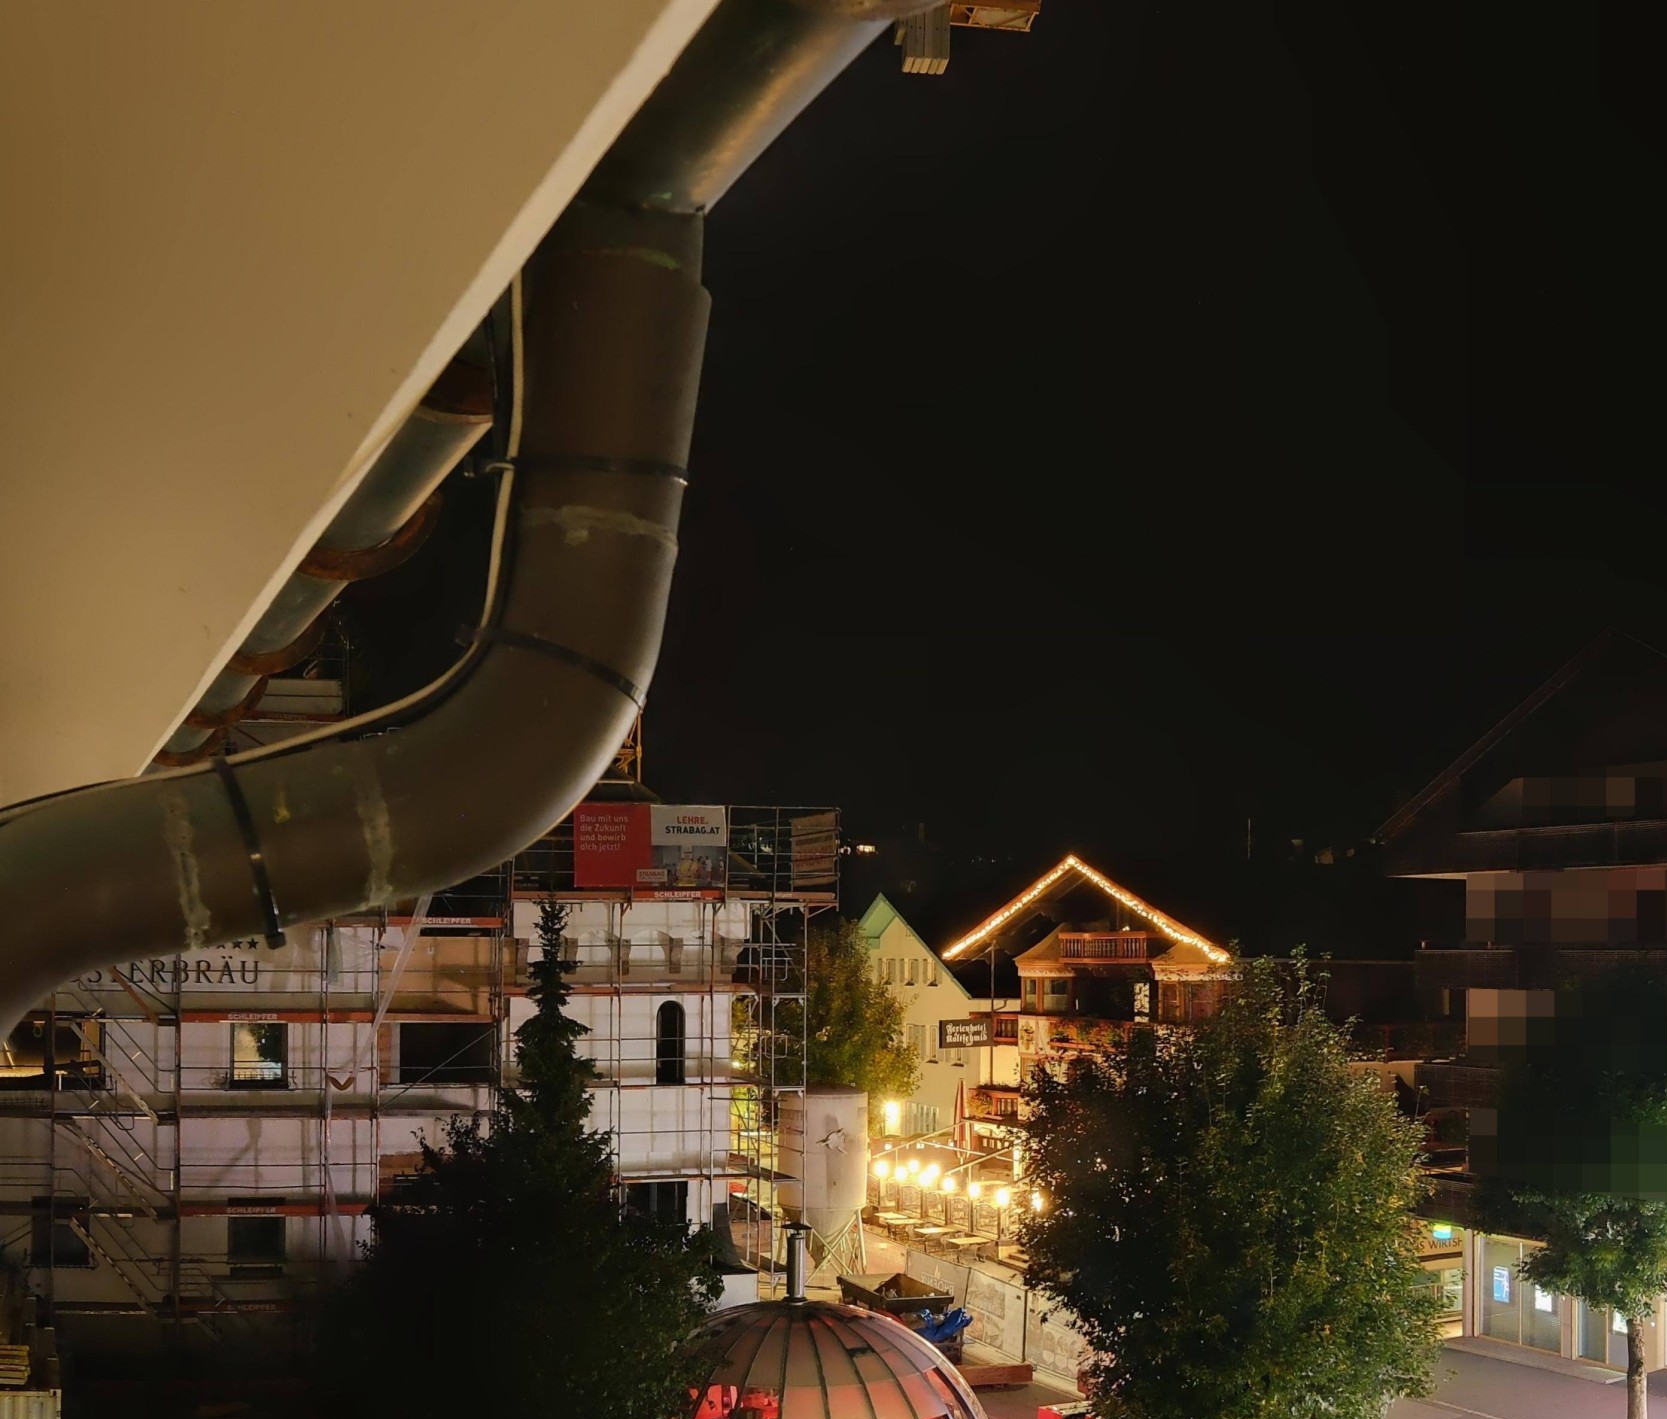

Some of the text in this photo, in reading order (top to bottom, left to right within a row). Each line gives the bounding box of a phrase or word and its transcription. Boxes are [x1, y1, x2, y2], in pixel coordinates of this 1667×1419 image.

[579, 814, 596, 822] Bau
[598, 814, 611, 822] mit
[676, 815, 709, 824] LEHRE.
[579, 824, 626, 832] die Zukunft
[665, 825, 720, 835] STRABAG.AT
[580, 833, 627, 841] und bewirb
[580, 843, 620, 853] dich jetzt!
[654, 890, 702, 898] SCHLEIPFER
[227, 1013, 278, 1021] SCHLEIPFER
[226, 1206, 277, 1214] SCHLEIPFER
